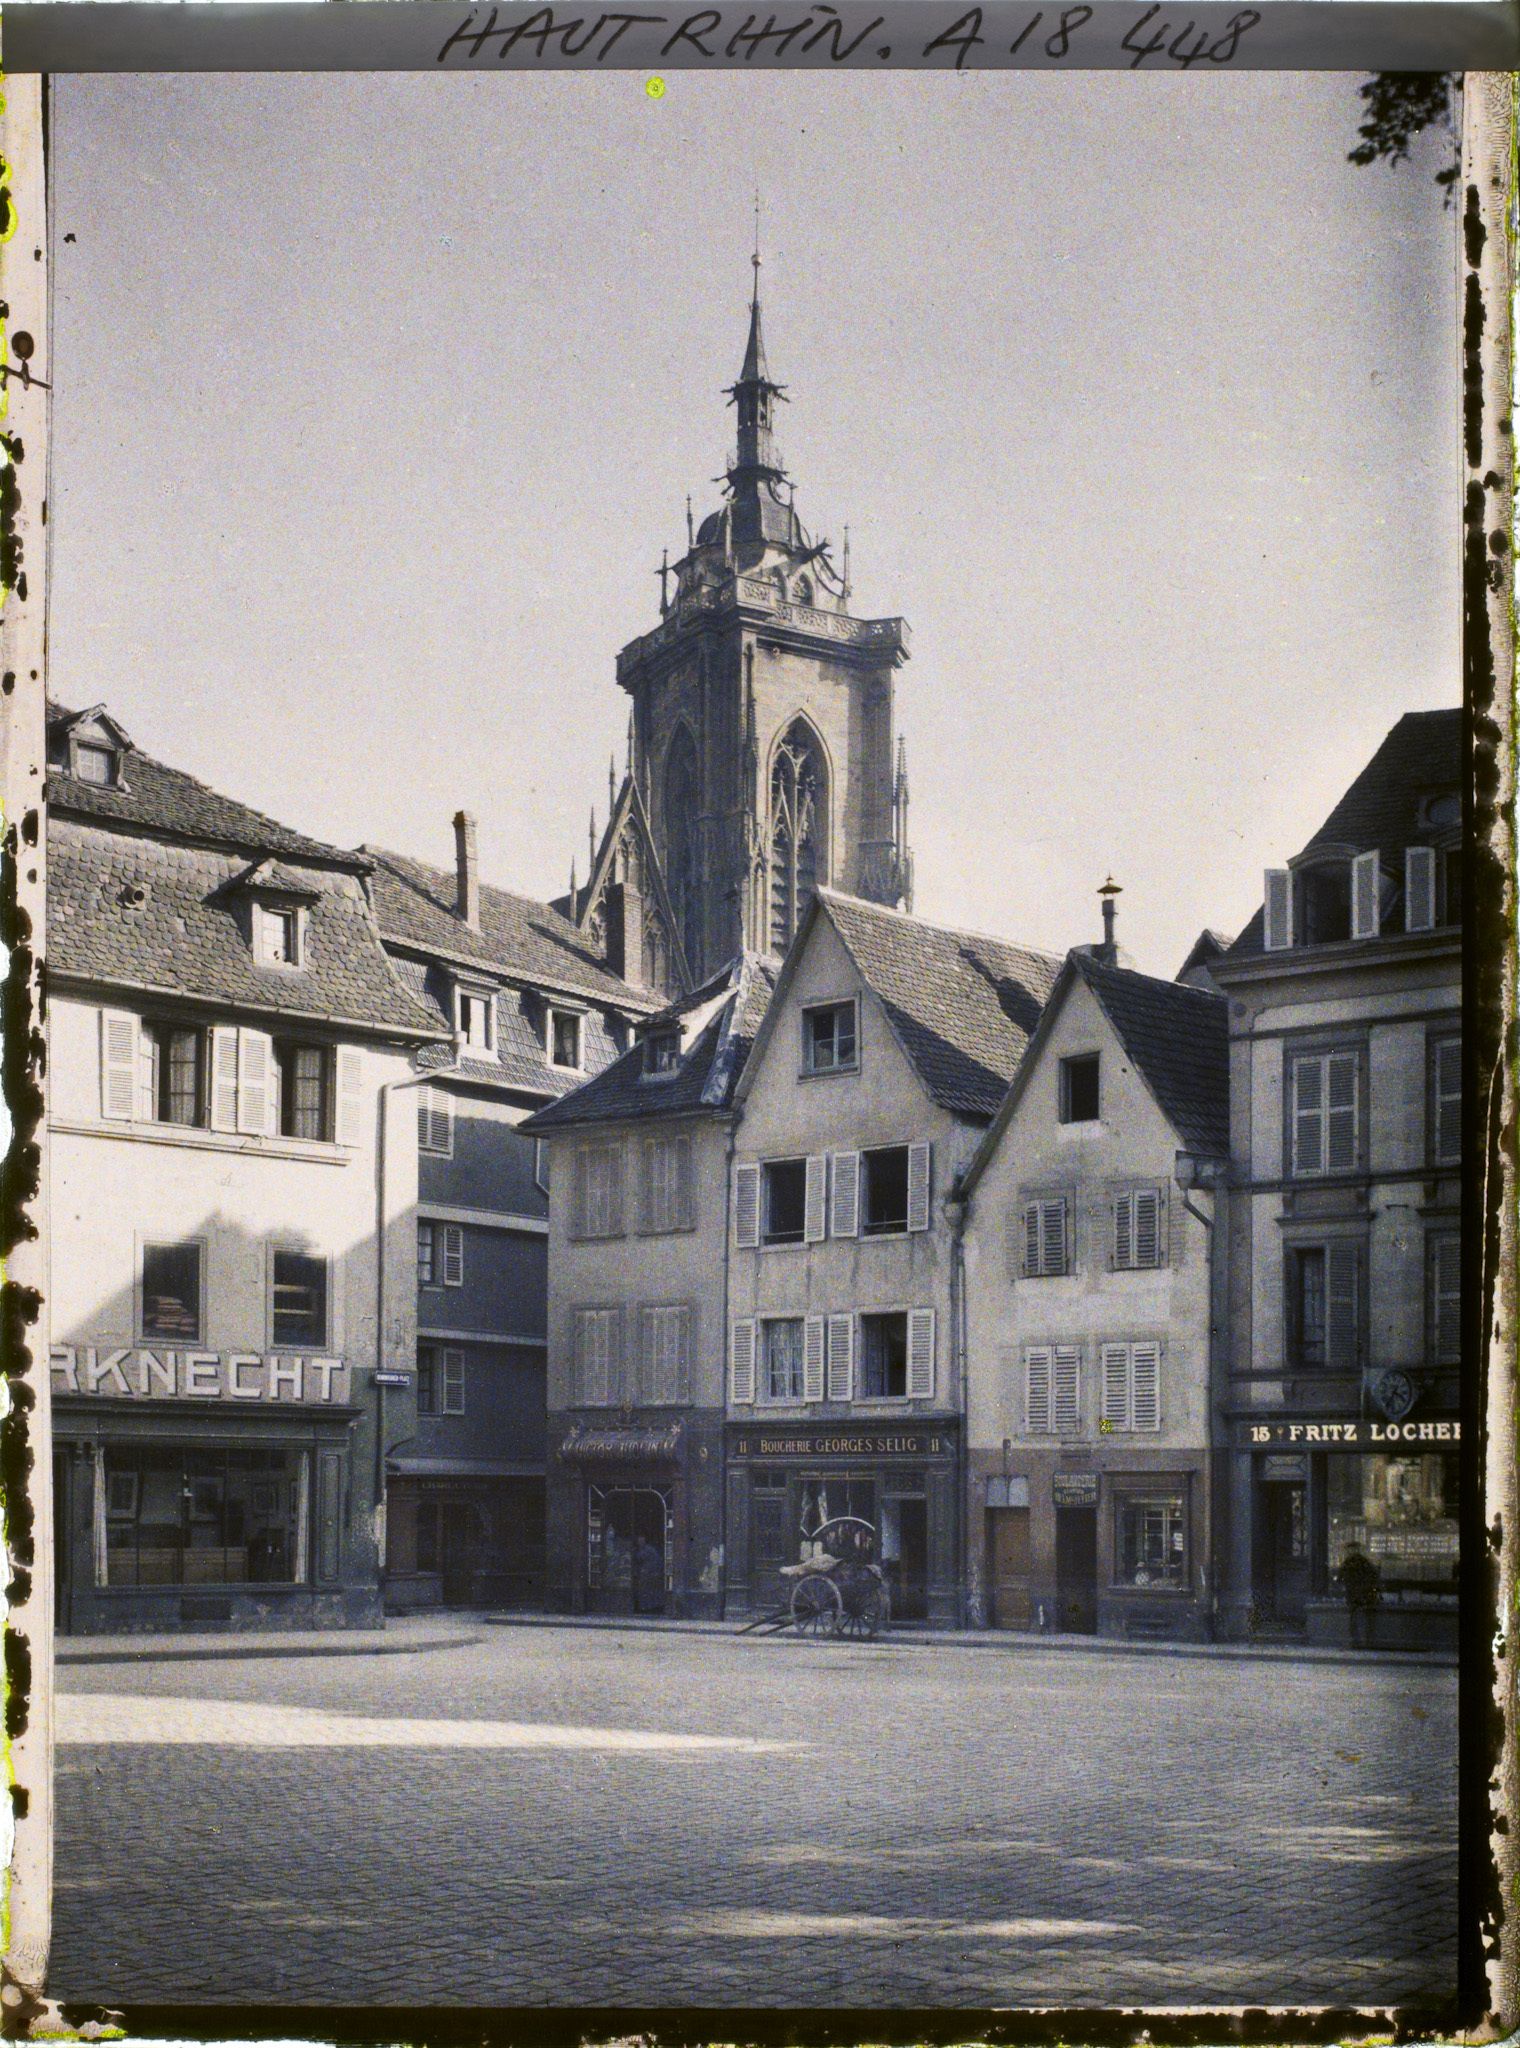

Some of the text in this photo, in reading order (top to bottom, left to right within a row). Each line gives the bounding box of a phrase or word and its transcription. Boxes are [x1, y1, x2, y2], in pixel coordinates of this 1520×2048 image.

[437, 3, 1261, 68] HAUT RHIN. A 18 448
[1250, 1425, 1271, 1443] 15
[1289, 1424, 1358, 1442] FRITZ
[760, 1437, 917, 1453] BOUCHERIE GEORGES SELIG
